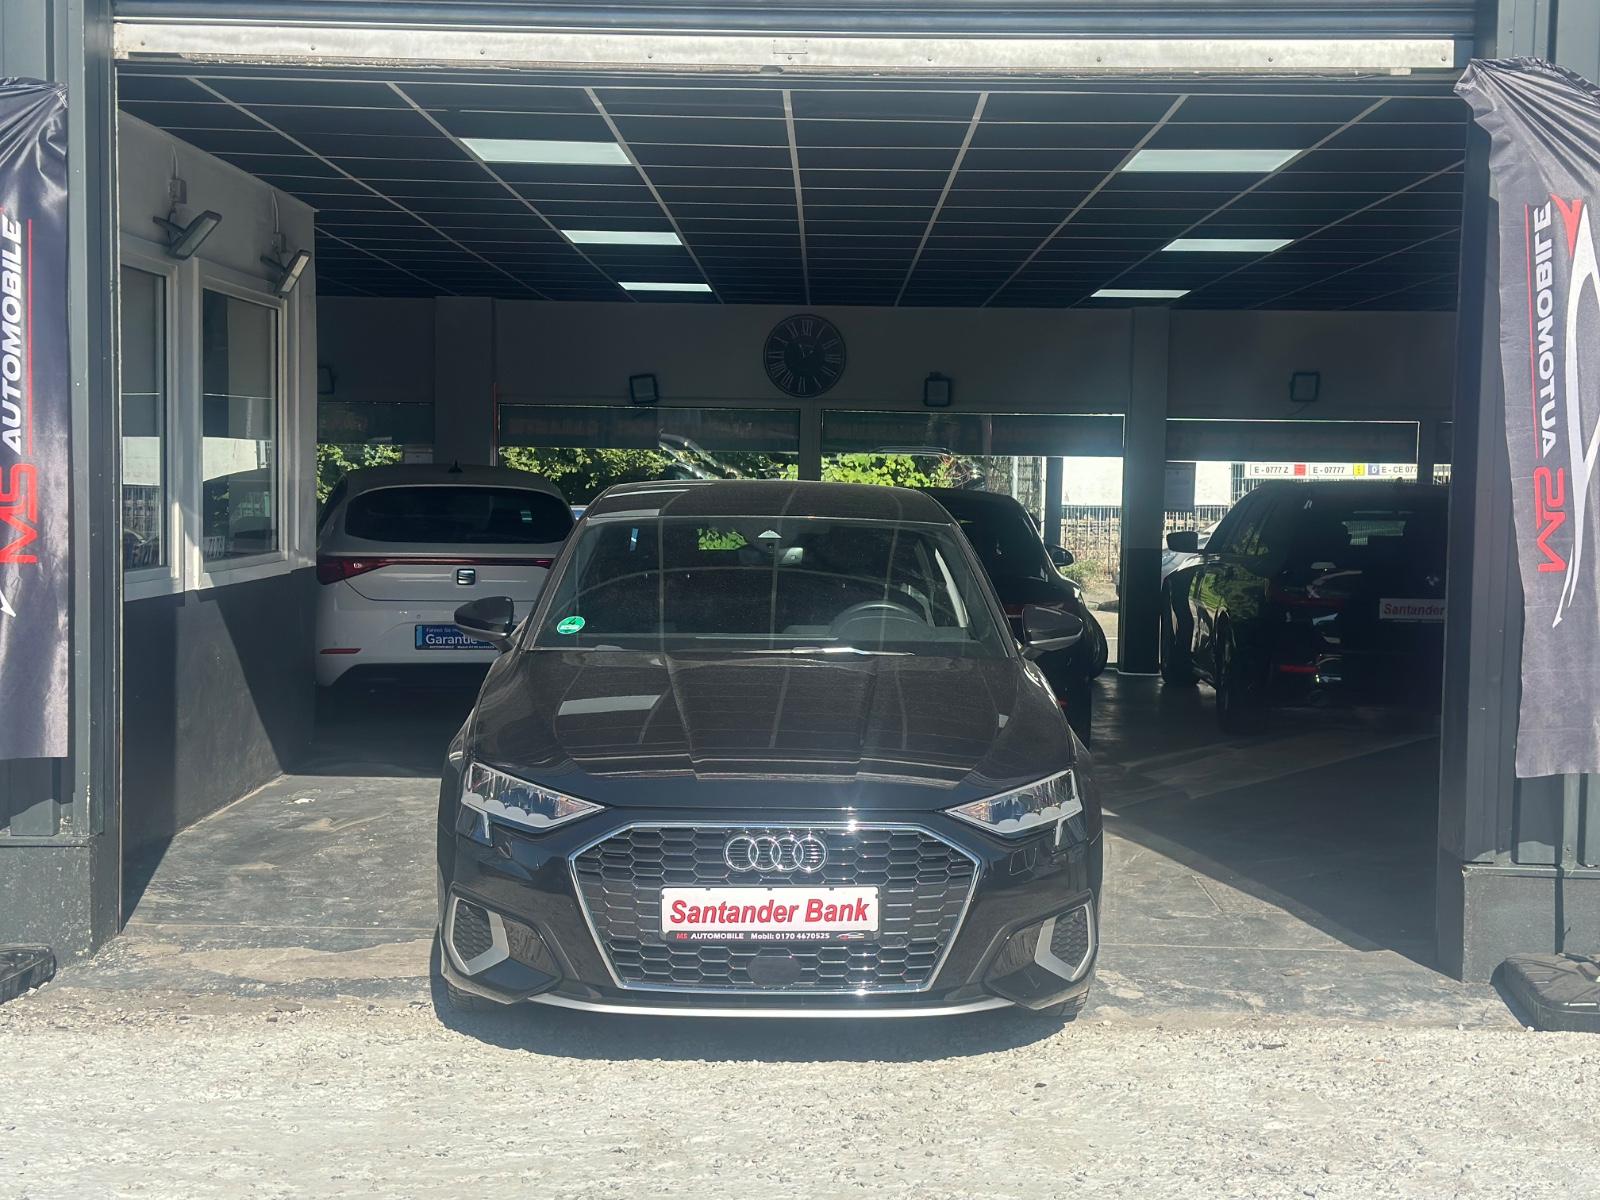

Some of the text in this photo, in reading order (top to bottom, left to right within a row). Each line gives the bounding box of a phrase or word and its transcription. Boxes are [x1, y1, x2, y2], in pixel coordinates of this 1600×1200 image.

[0, 214, 39, 564] MS AUTOMOBILE
[670, 898, 870, 924] Santander Bank
[690, 932, 745, 940] AUTOMOBILE
[750, 932, 774, 940] Mobil:
[775, 932, 795, 940] 0170
